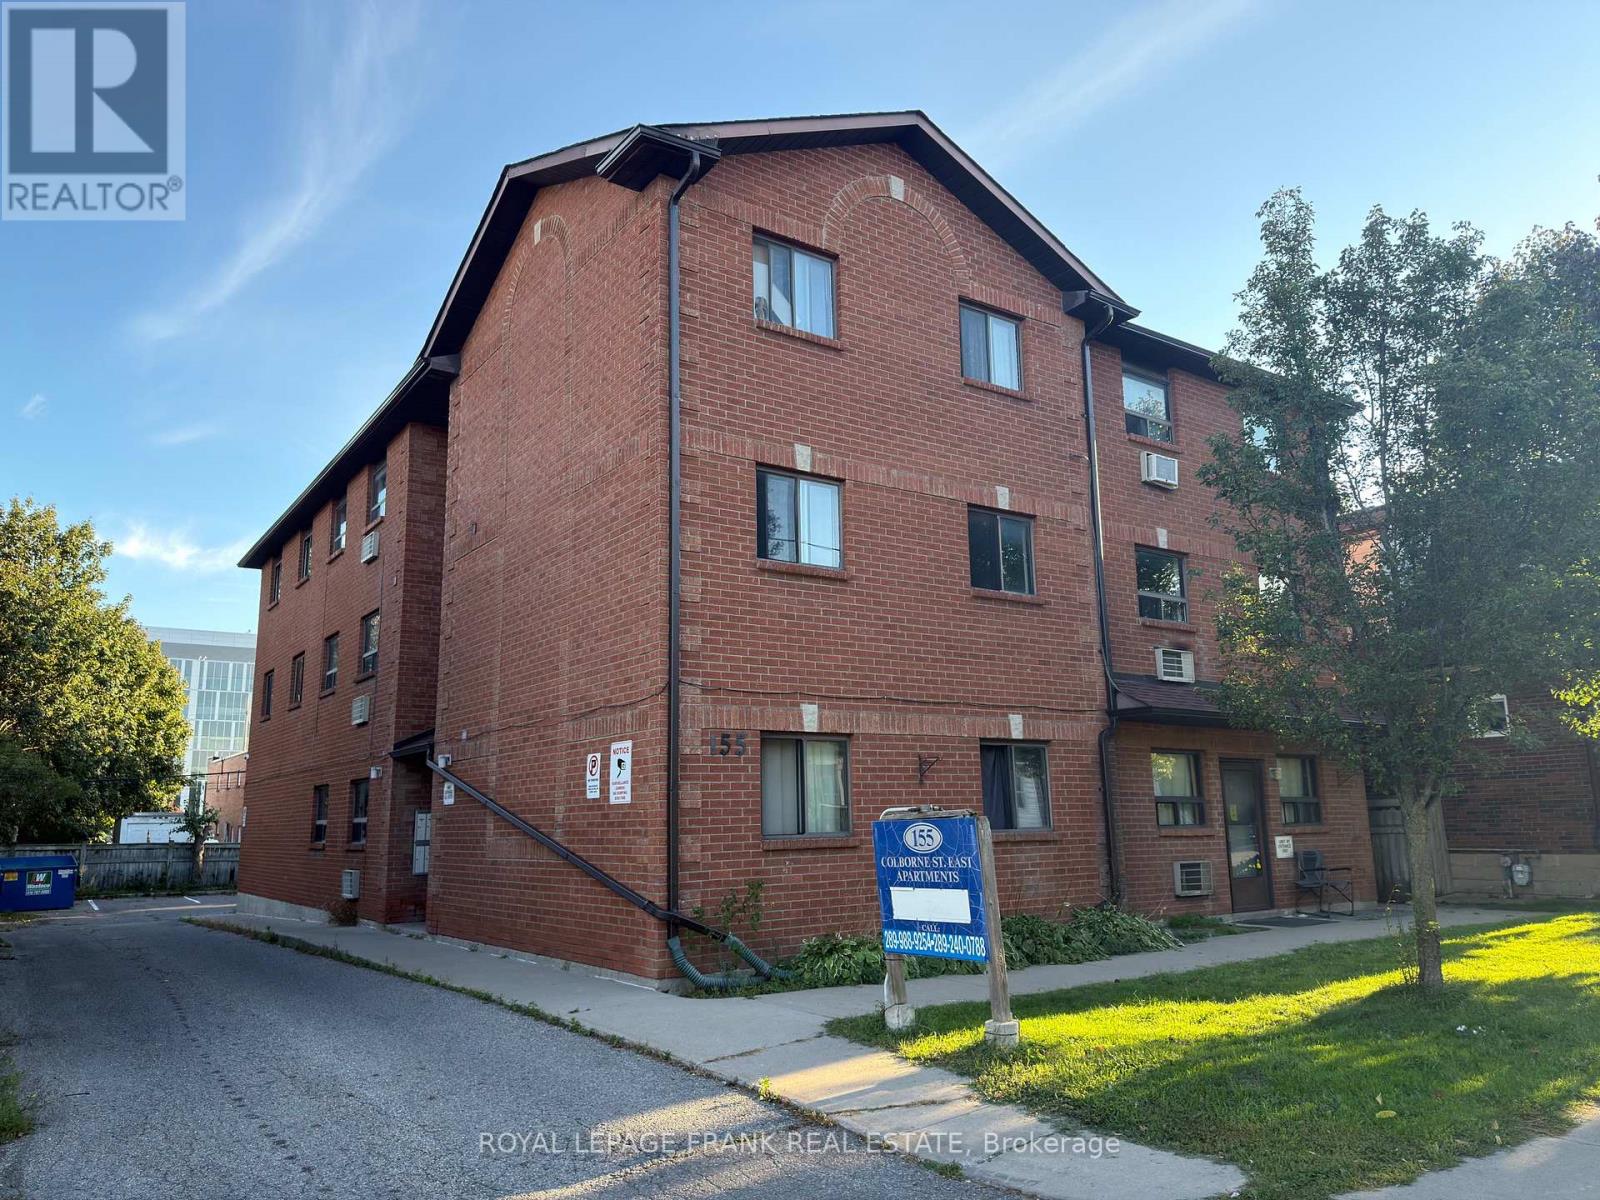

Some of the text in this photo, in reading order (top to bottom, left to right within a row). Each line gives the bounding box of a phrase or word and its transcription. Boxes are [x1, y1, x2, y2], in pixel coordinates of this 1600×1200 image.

[711, 731, 746, 757] 155
[613, 746, 630, 755] NOTICE
[912, 829, 934, 847] 155
[881, 856, 972, 868] COLBORNE ST. EAST
[896, 870, 960, 883] APARTMENTS
[921, 924, 941, 933] CALL:
